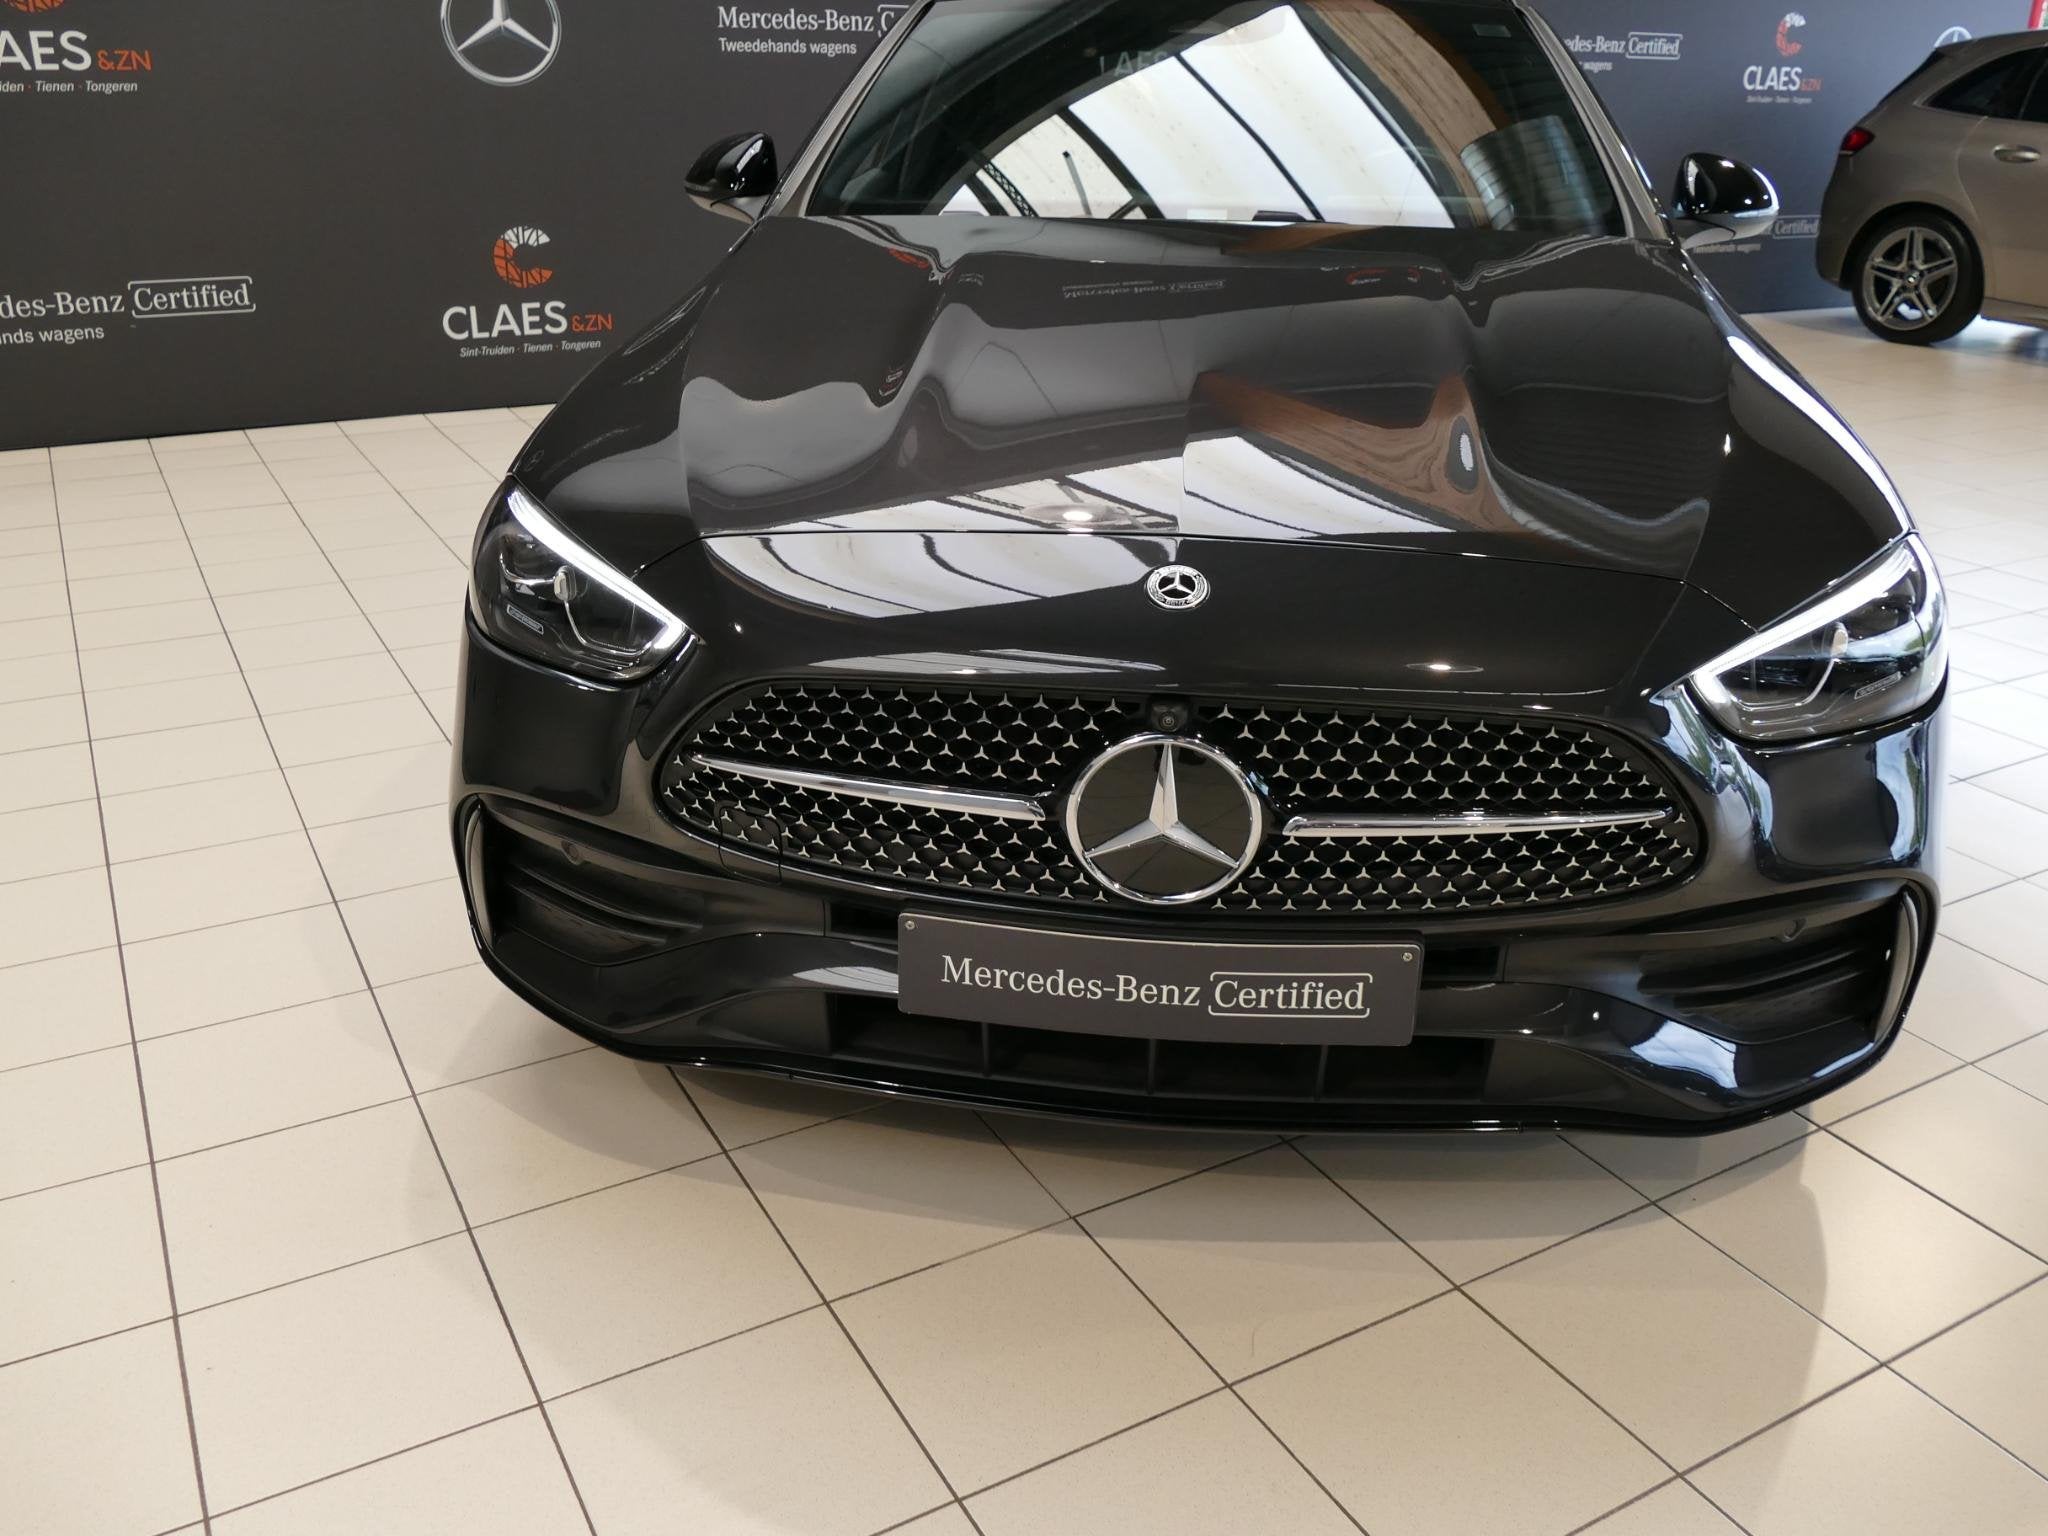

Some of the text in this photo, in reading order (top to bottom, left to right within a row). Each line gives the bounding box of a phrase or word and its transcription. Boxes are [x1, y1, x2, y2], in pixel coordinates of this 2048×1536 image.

[717, 6, 874, 32] Mercedes-Benz
[718, 37, 857, 57] Tweedehands wagens
[1628, 37, 1680, 55] Certified
[97, 49, 152, 71] &ZN
[35, 80, 75, 92] Tienen
[85, 80, 138, 95] Tongeren
[1743, 65, 1802, 91] CLAES
[133, 284, 250, 312] Certified
[442, 300, 613, 340] CLAES &ZN
[0, 327, 105, 345] nds wagens
[460, 340, 602, 358] Sint-Truiden Tienen Tongeren
[941, 954, 1366, 1010] Mercedes-Benz Certified
